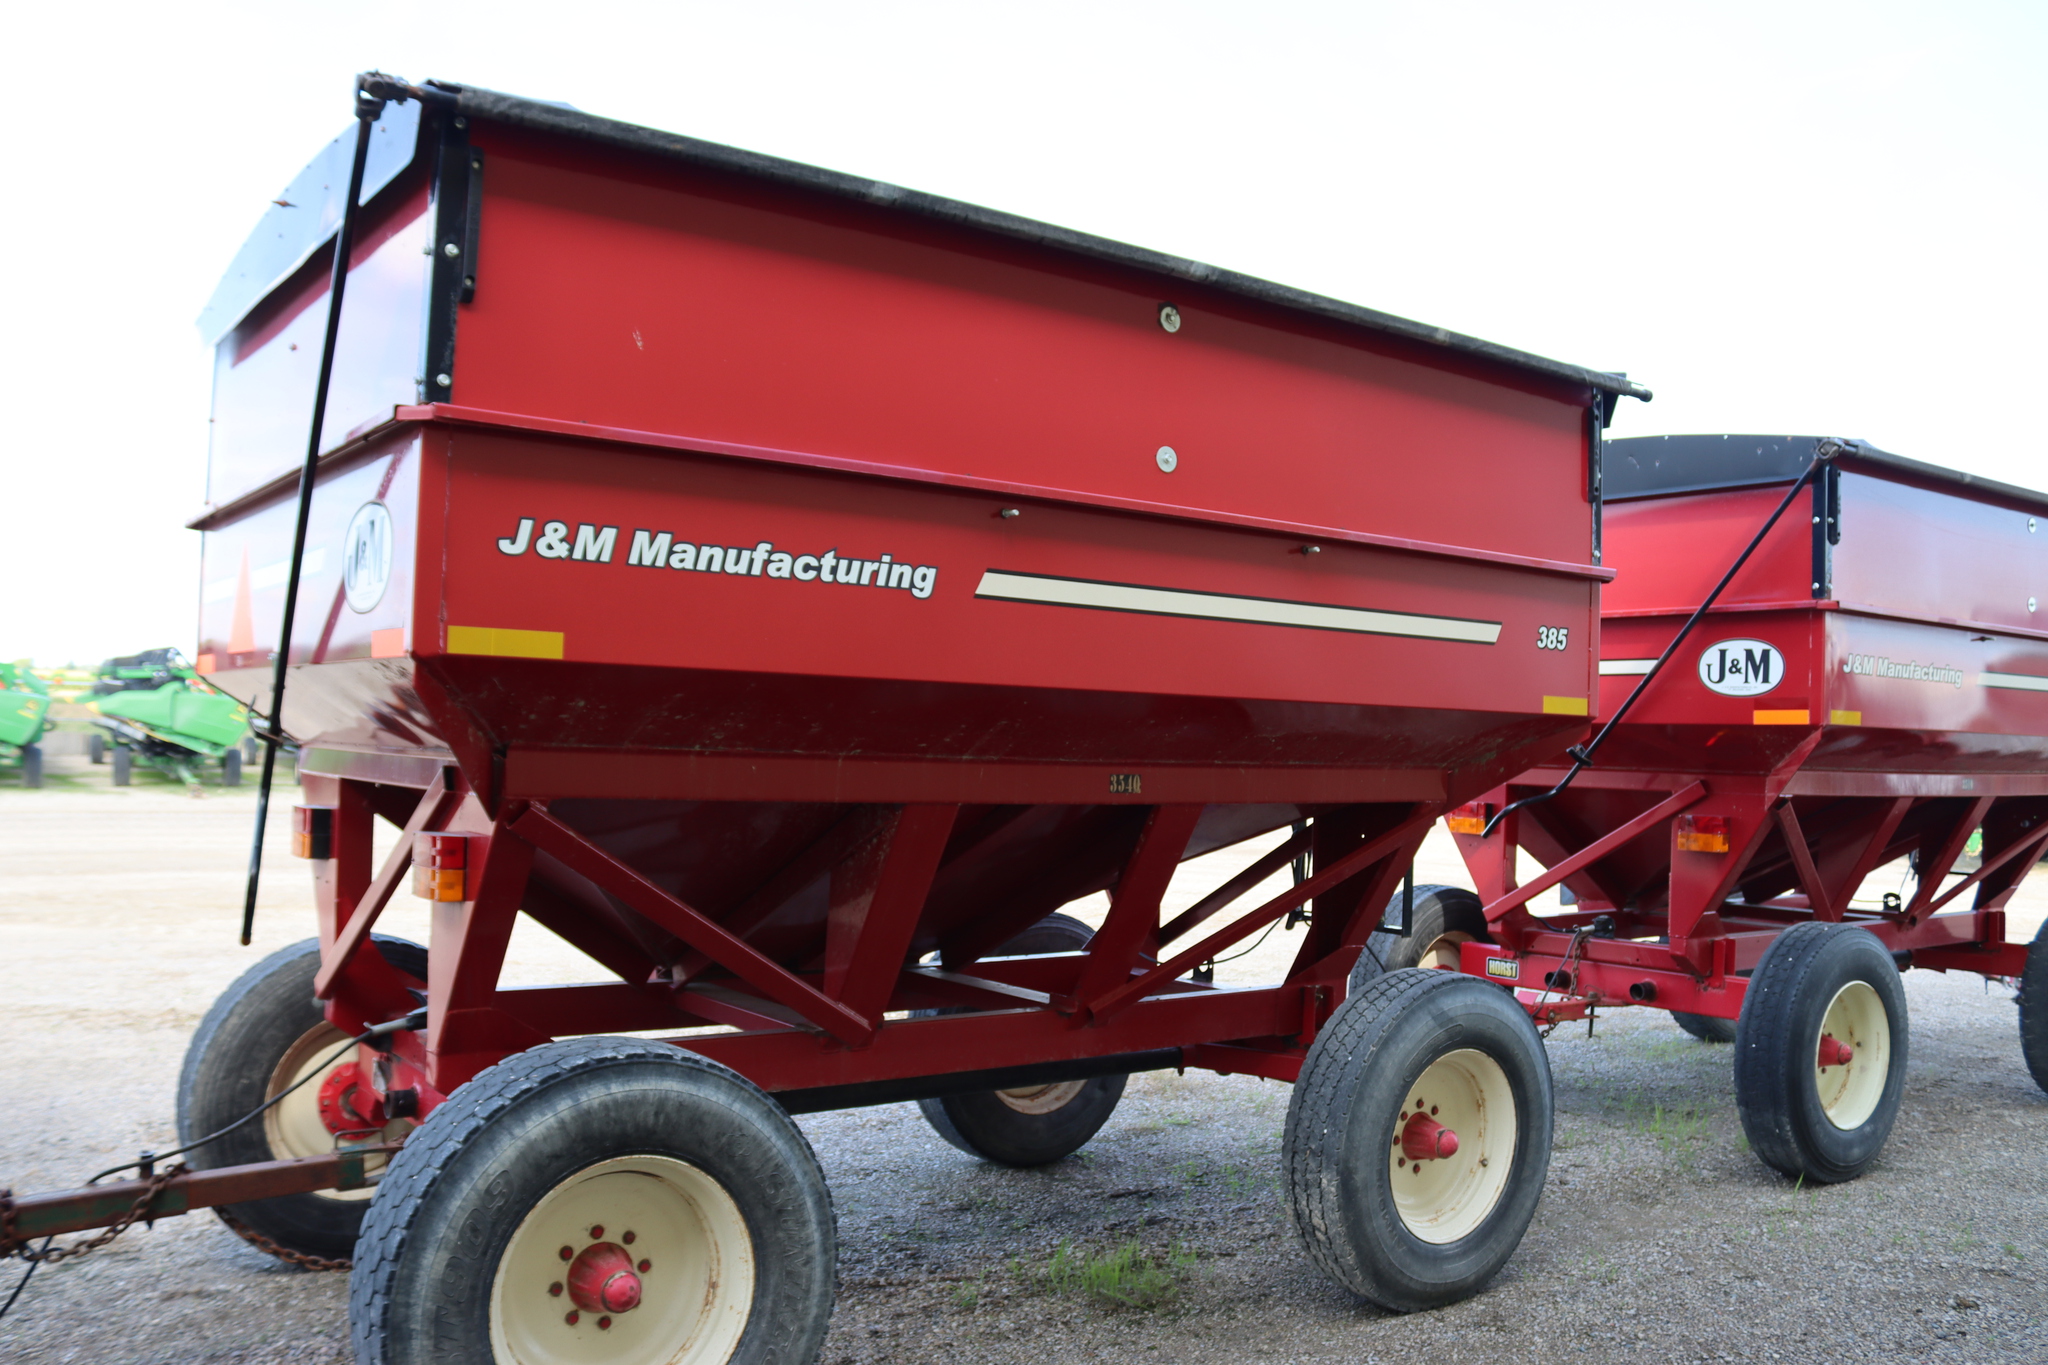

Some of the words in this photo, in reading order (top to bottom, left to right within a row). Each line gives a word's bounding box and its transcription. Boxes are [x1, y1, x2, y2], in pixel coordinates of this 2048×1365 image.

[347, 515, 386, 592] J&M
[498, 517, 618, 563] J&M
[627, 529, 938, 599] Manufacturing
[1537, 625, 1568, 651] 385
[1706, 648, 1772, 684] J&M
[1842, 653, 1875, 676] J&M
[1876, 656, 1963, 688] Manufacturing
[1488, 960, 1517, 977] HORST
